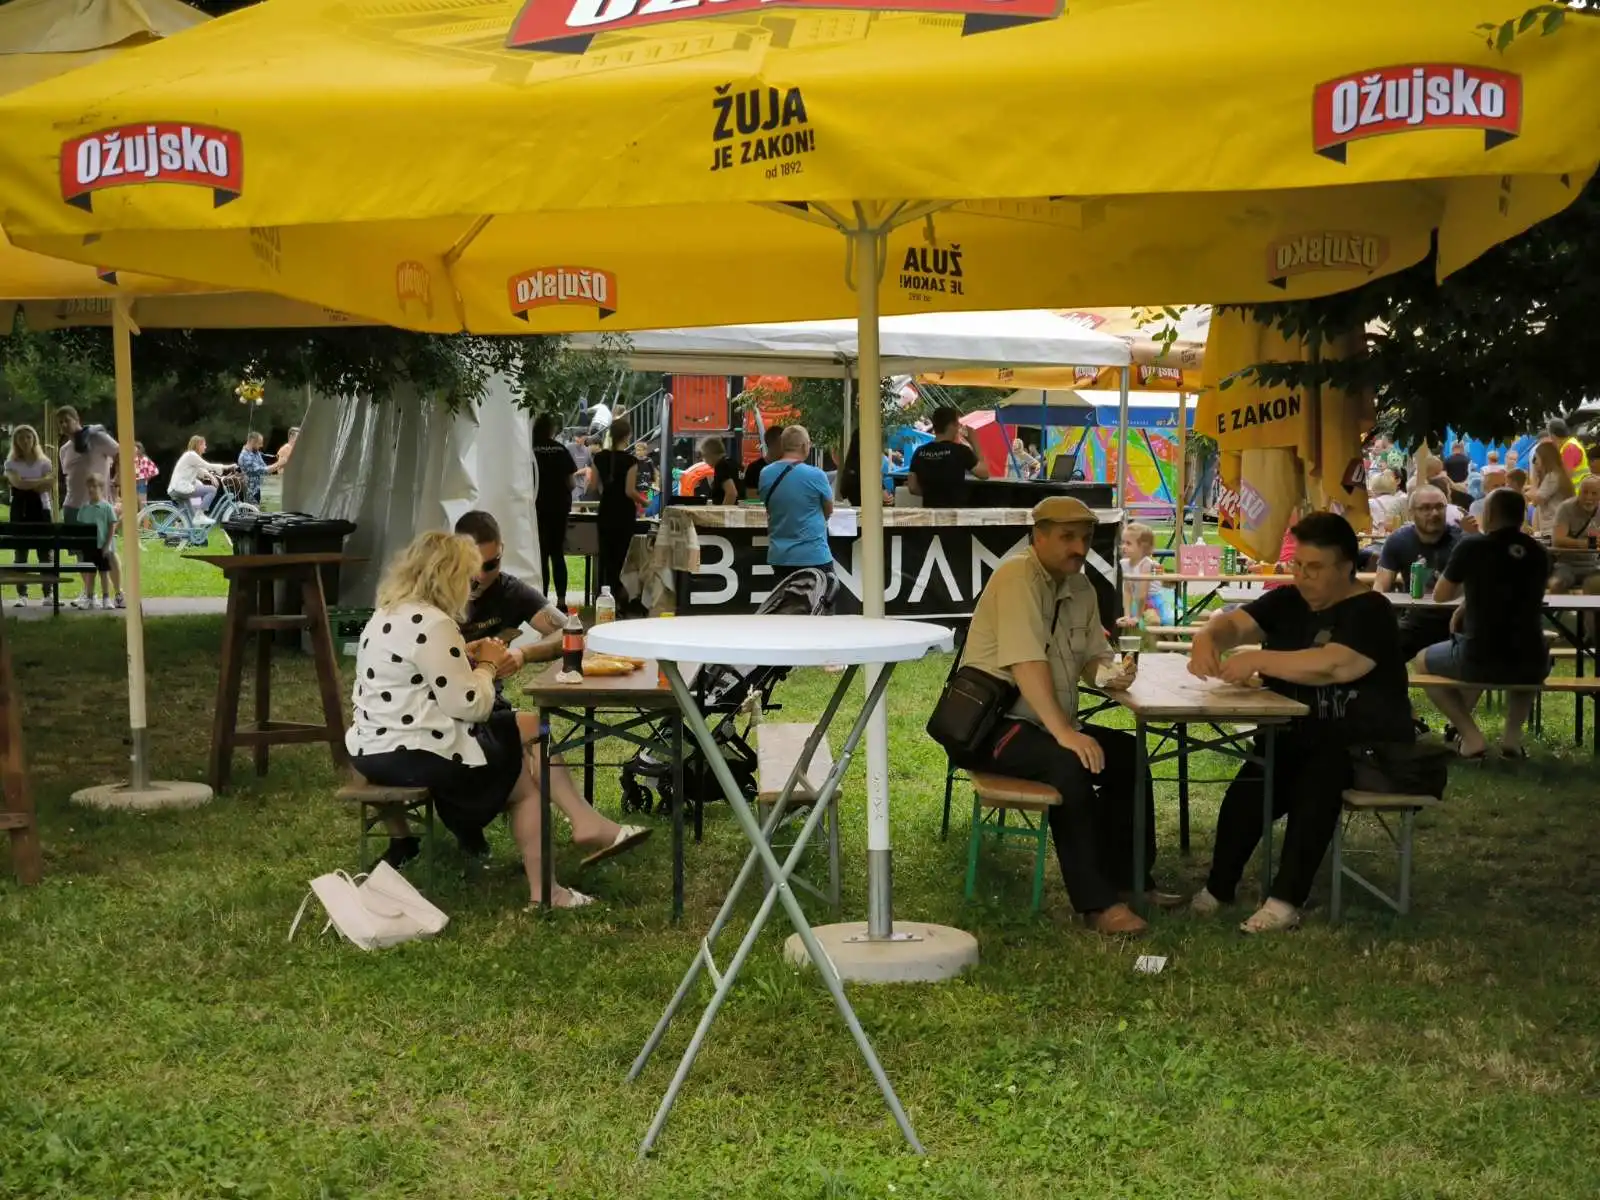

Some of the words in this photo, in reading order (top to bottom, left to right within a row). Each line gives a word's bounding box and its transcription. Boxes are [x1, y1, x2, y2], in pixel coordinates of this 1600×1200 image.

[712, 83, 808, 142] ŽUJA
[1331, 68, 1505, 134] Ožujsko
[76, 125, 229, 184] Ožujsko
[710, 145, 733, 171] JE
[740, 128, 816, 164] ZAKON!
[765, 165, 777, 180] od
[1231, 394, 1301, 431] ZAKON
